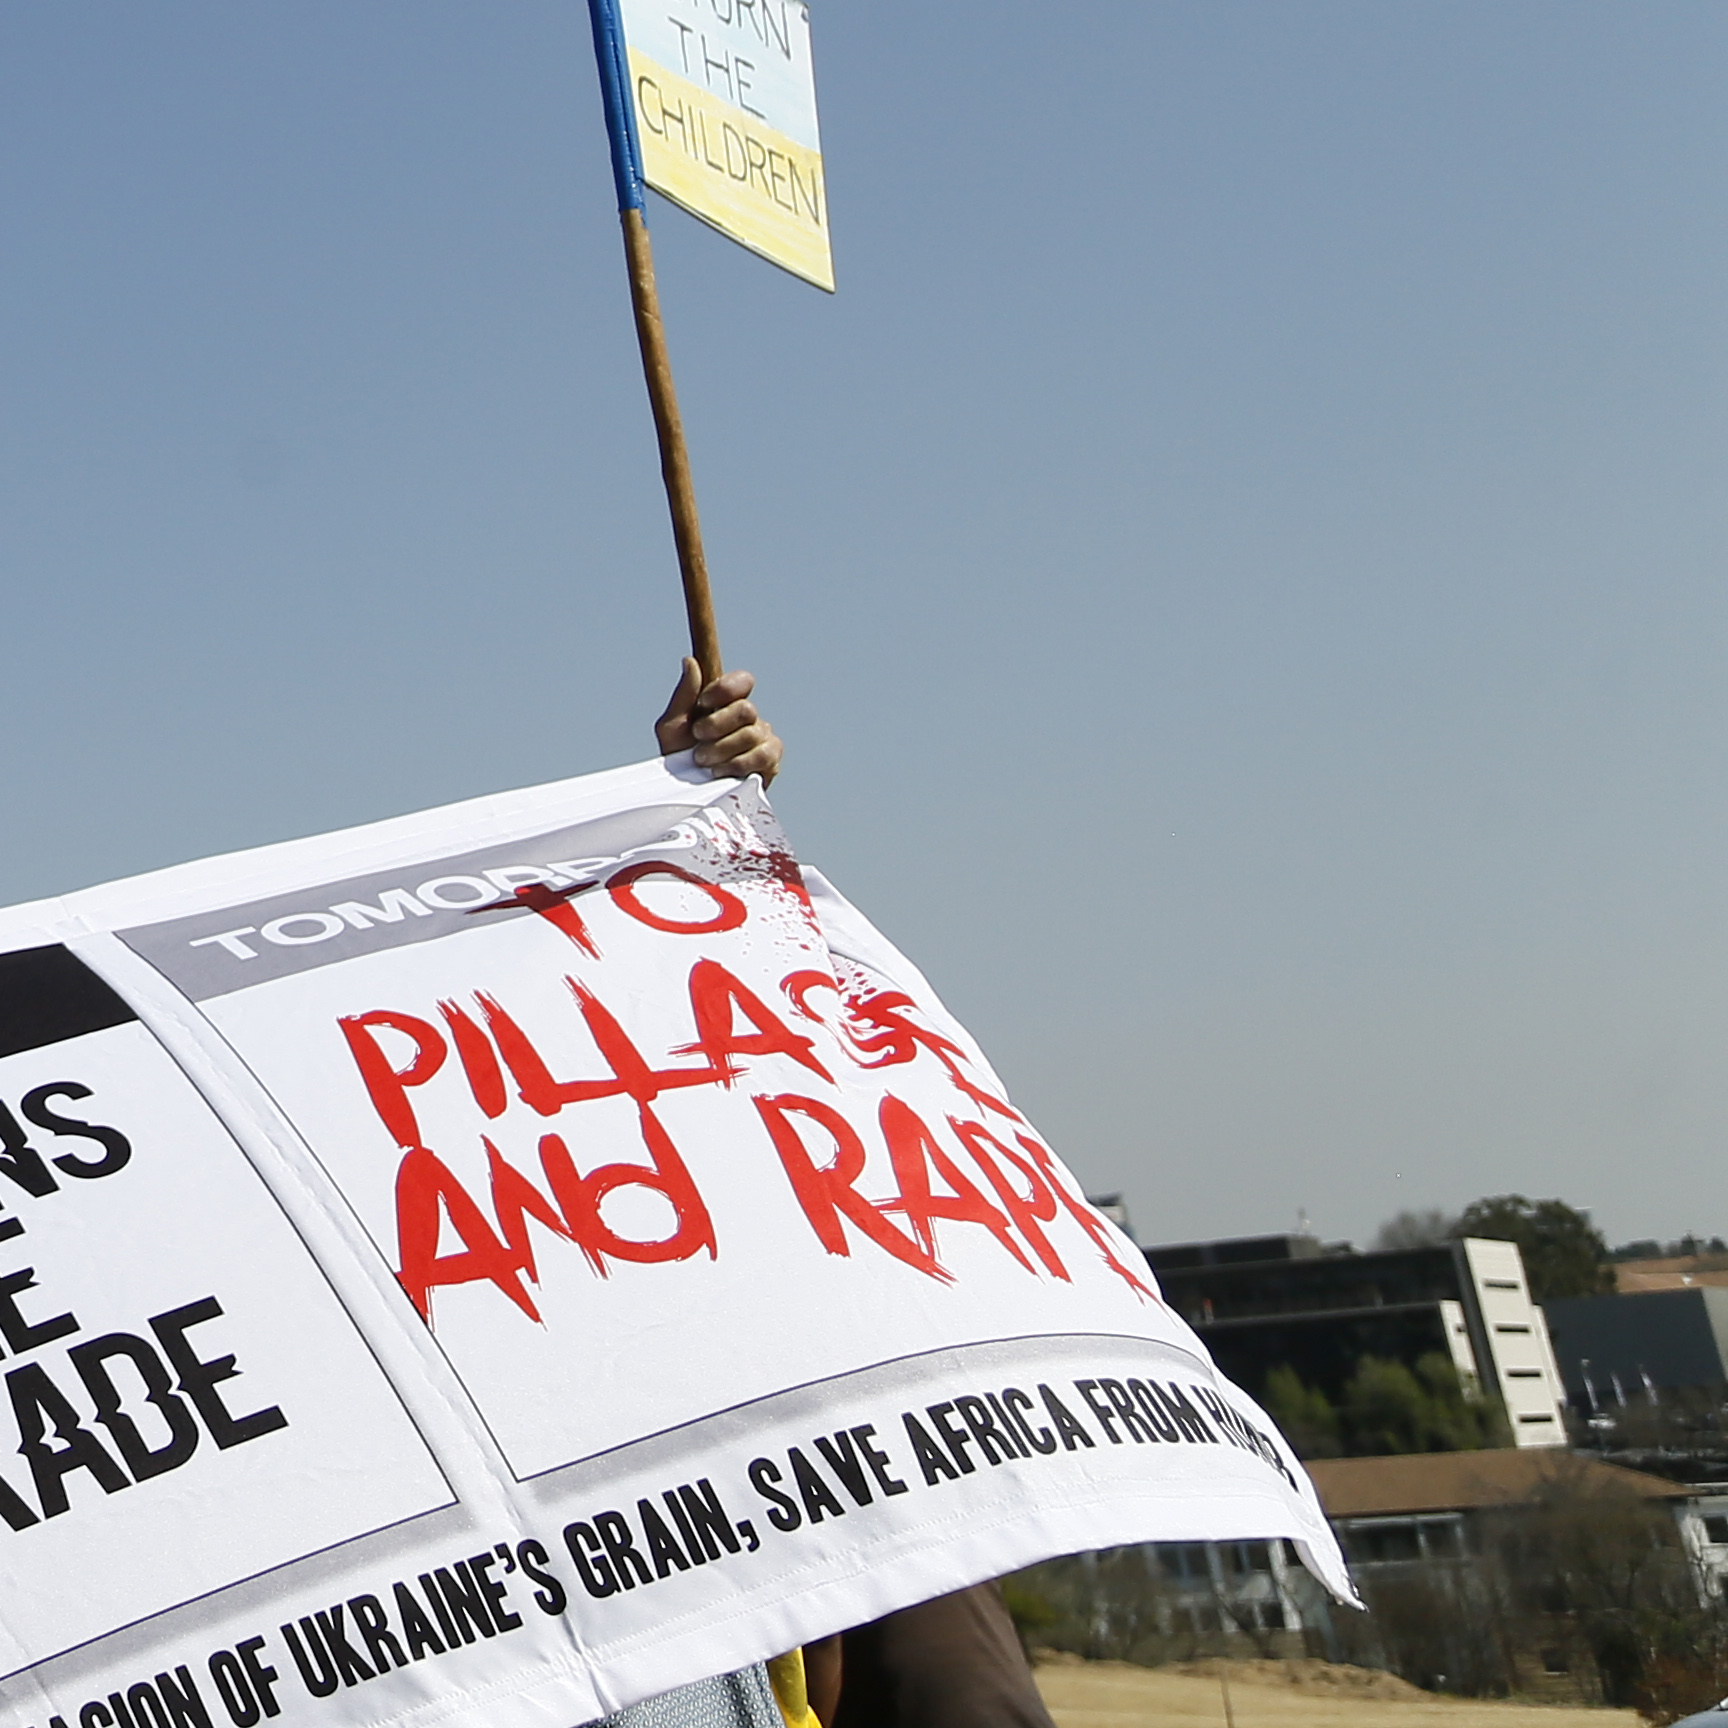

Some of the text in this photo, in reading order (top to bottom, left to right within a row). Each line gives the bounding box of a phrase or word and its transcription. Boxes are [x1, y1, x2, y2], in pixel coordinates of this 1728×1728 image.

[667, 15, 767, 120] THE
[636, 75, 821, 226] CHILDREN
[464, 859, 748, 962] TO
[208, 1635, 282, 1728] OF
[280, 1538, 568, 1699] UKRAINE'S
[562, 1477, 761, 1599] GRAIN,
[747, 1423, 909, 1532] SAVE
[900, 1383, 1096, 1487] AFRICA
[1072, 1377, 1221, 1444] FROM
